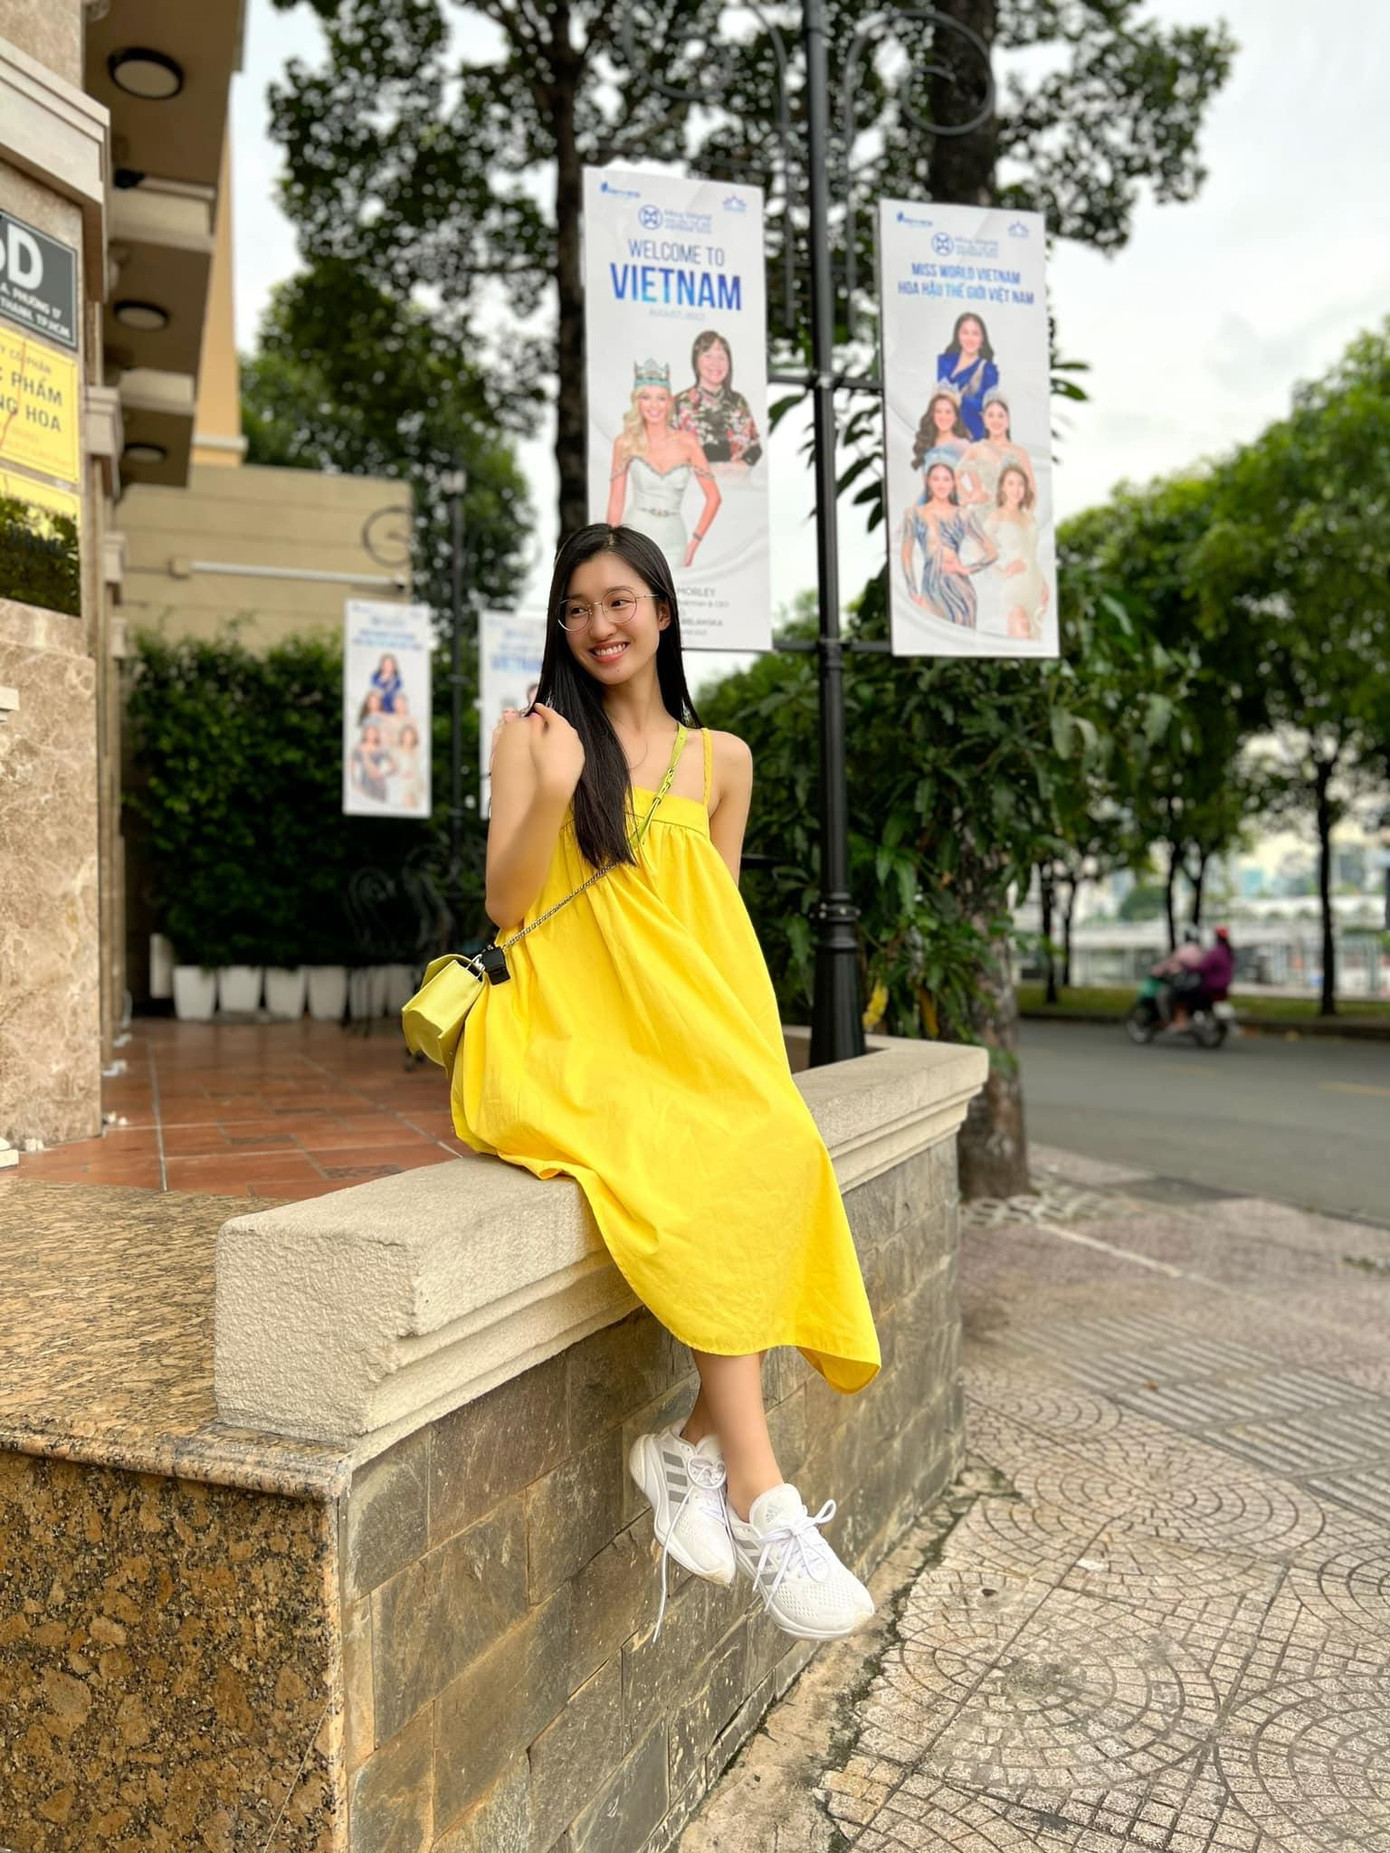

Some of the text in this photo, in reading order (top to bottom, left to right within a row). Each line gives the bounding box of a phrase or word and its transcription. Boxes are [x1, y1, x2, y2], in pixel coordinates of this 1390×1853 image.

[628, 238, 725, 268] WELCOME TO
[610, 262, 742, 311] VIETNAM
[911, 262, 1021, 285] MISS WORLD VIETNAM
[897, 280, 919, 295] HOA
[1012, 290, 1034, 305] NAM
[26, 404, 62, 433] HOA
